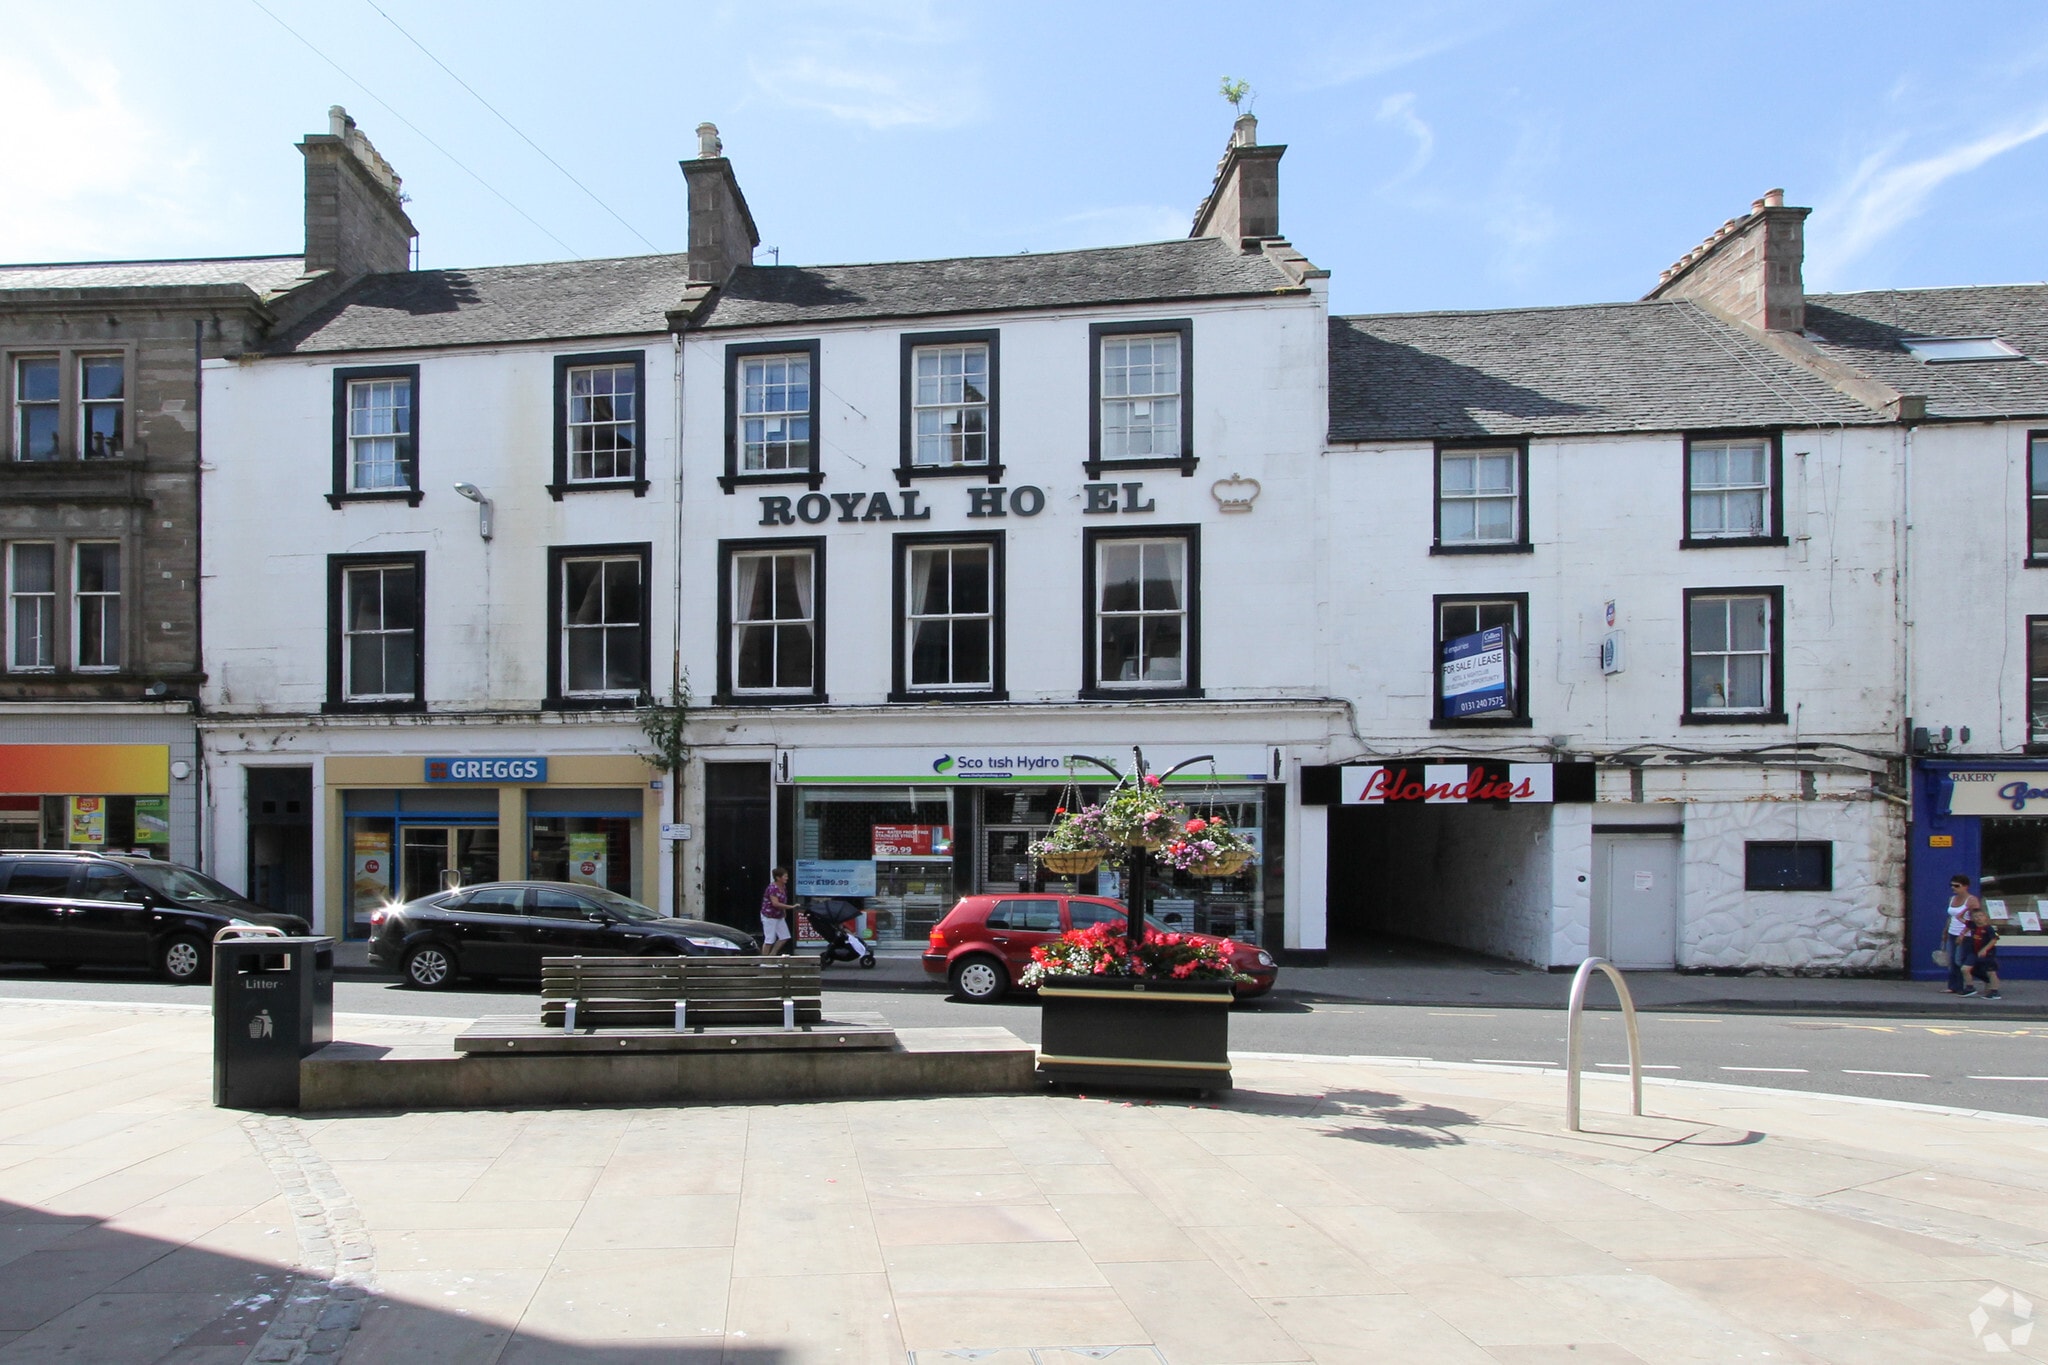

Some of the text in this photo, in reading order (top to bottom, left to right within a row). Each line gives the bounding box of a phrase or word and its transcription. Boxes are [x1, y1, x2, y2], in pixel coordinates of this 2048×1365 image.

[758, 491, 930, 526] ROYAL
[1443, 664, 1454, 674] FOR
[1456, 660, 1471, 672] SALE
[1478, 653, 1502, 667] LEASE
[1460, 696, 1504, 711] 0131 240 7575
[451, 760, 538, 779] GREGGS
[1017, 756, 1060, 771] Hydro
[1359, 766, 1535, 801] Blondies
[1952, 773, 1997, 782] BAKERY
[245, 980, 279, 989] Litter
